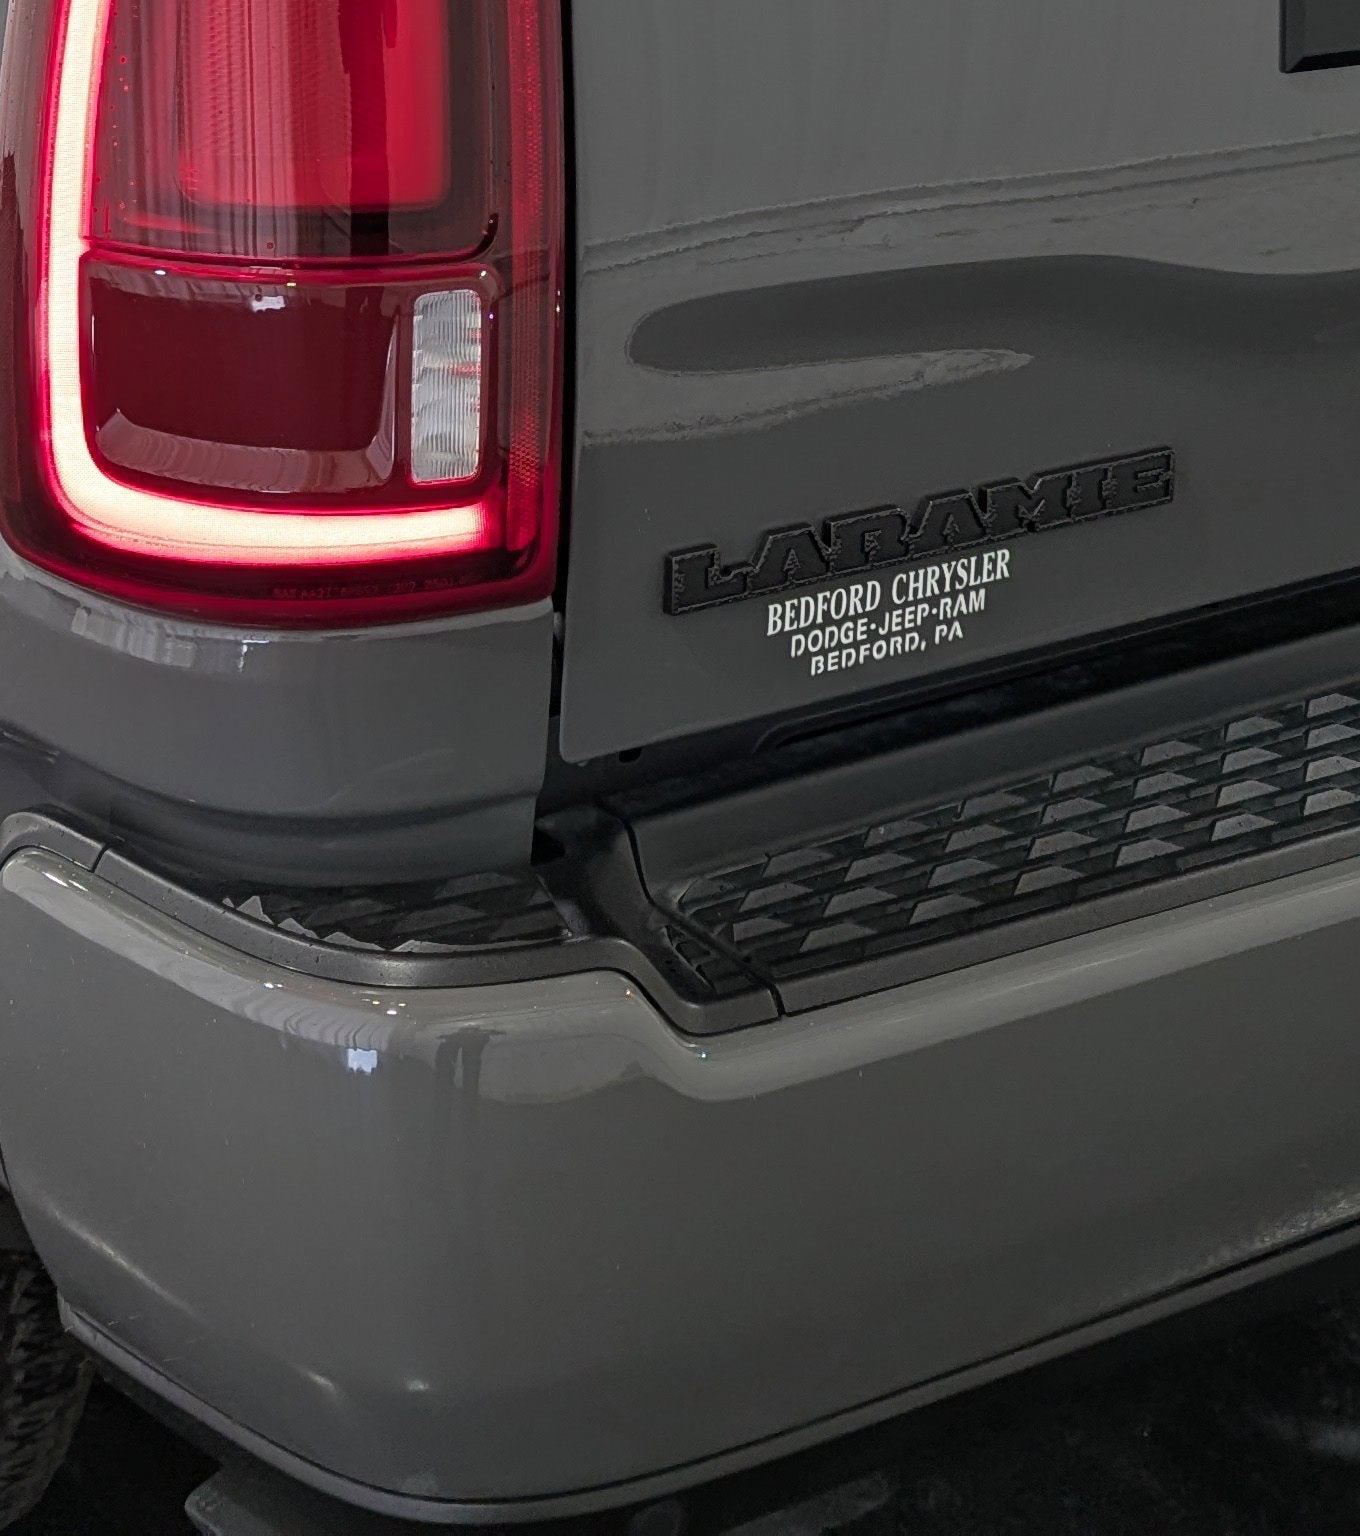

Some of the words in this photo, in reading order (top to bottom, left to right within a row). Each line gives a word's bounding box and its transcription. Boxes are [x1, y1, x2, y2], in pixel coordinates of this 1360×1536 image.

[663, 446, 1176, 617] LARAMIE
[766, 580, 881, 636] BEDFORD
[891, 548, 1011, 605] CHRYSLER
[810, 632, 927, 677] BEDFORD,
[934, 620, 964, 644] PA
